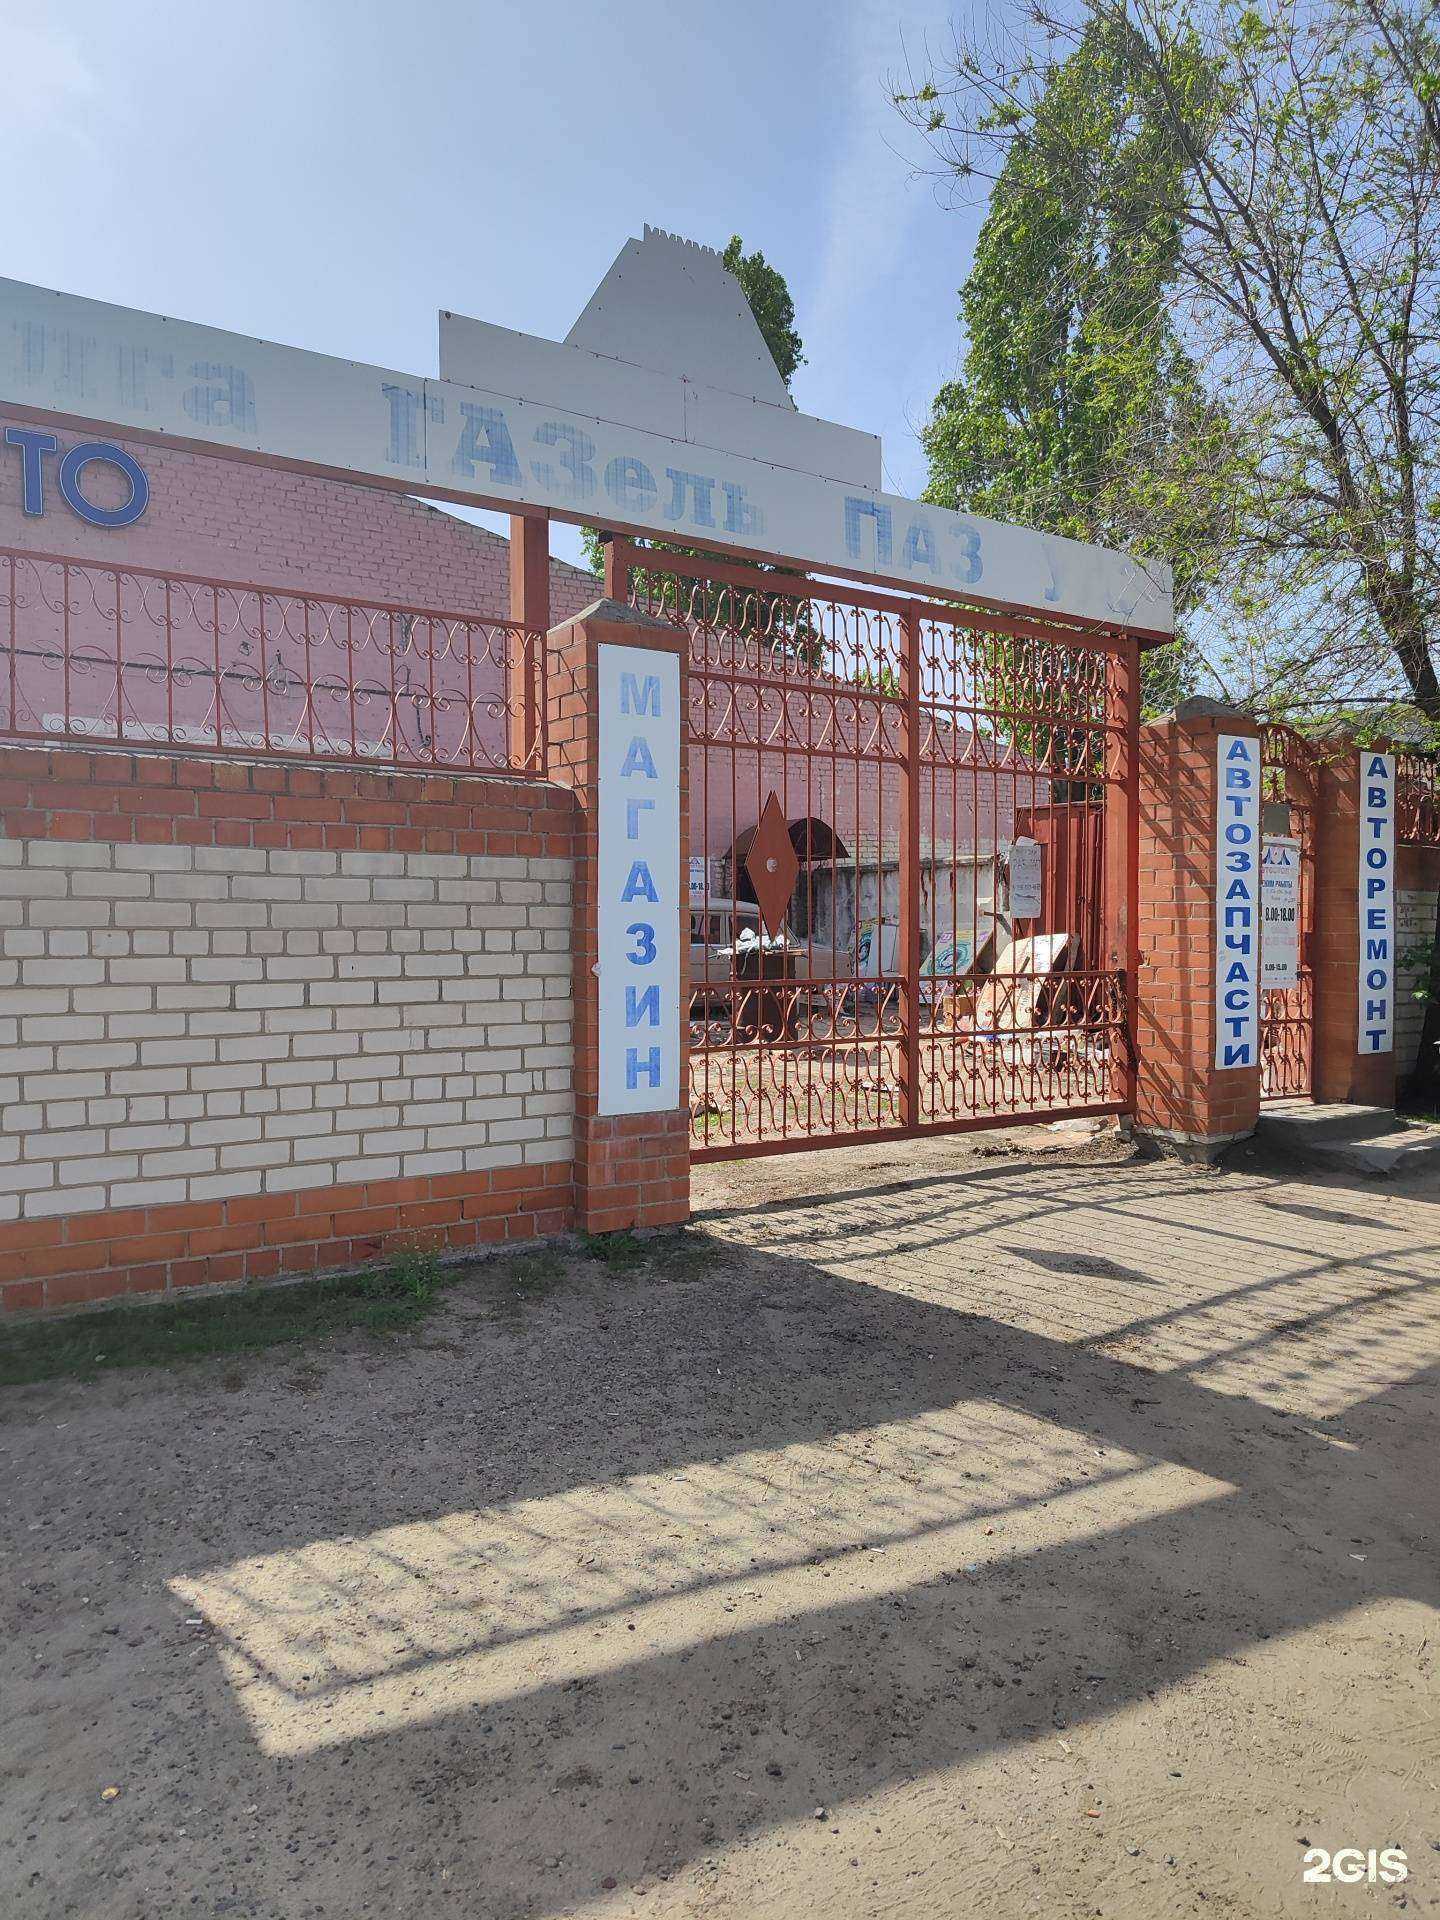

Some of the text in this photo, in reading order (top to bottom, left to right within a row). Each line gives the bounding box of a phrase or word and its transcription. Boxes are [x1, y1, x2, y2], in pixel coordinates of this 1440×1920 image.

[5, 426, 150, 528] ТО
[844, 495, 982, 585] ПАЗ
[619, 672, 662, 1090] МАГАЗИН
[1224, 739, 1251, 1066] АВТОЗАПЧАСТИ
[1366, 756, 1388, 1051] АВТОРЕМОНТ
